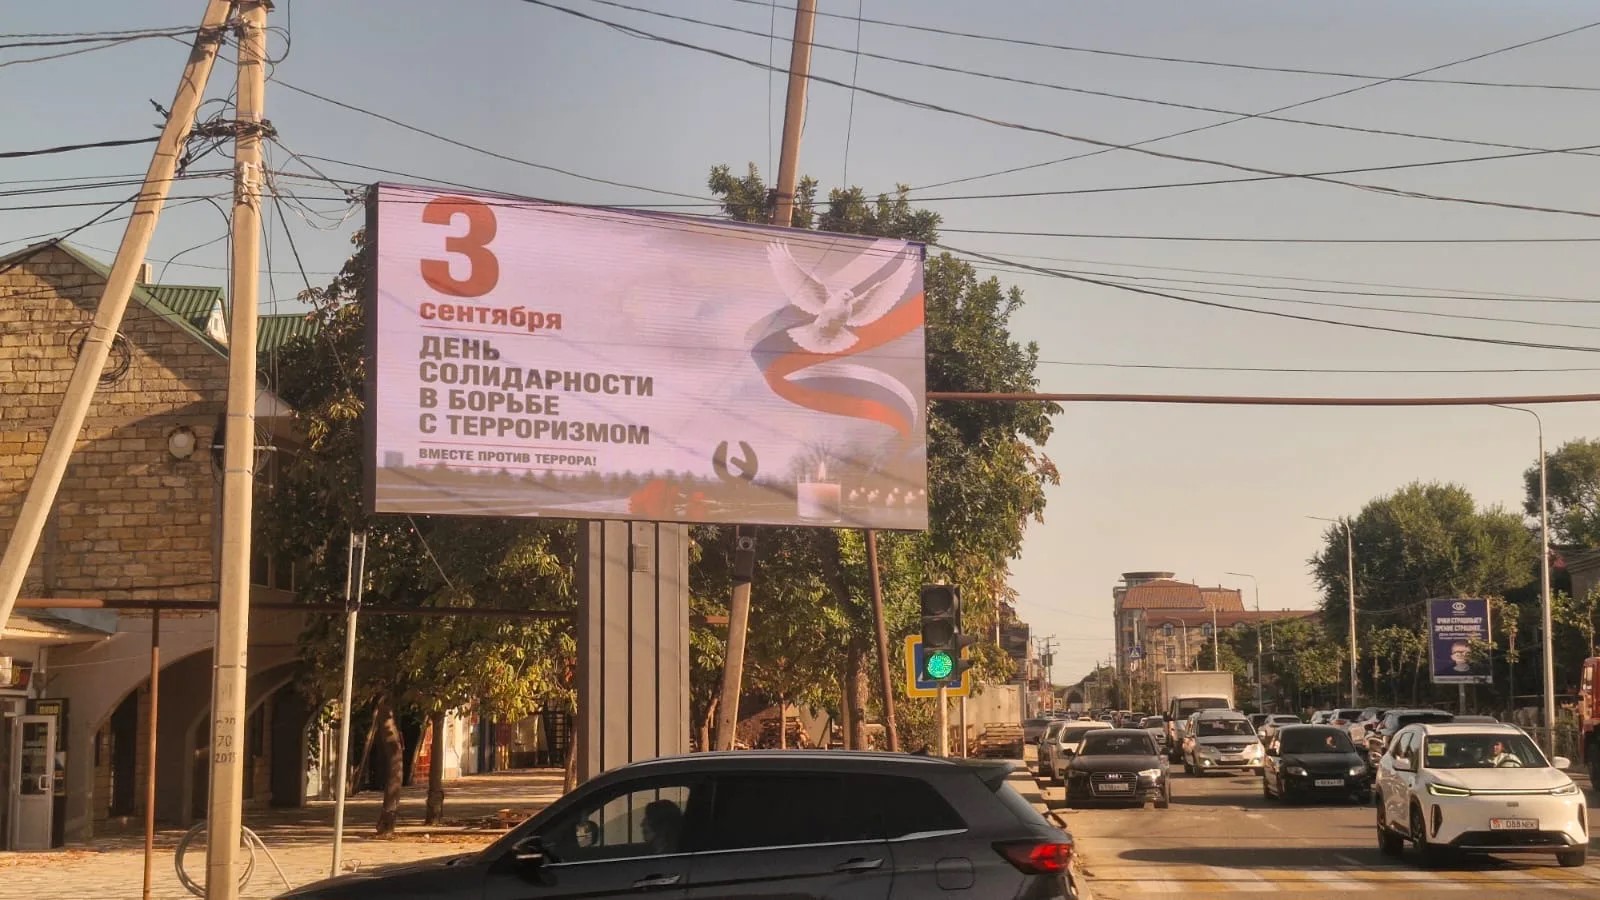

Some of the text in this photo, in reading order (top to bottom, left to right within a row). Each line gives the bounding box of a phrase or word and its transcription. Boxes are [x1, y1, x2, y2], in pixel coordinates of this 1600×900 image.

[420, 195, 500, 298] 3
[419, 301, 563, 332] сентября
[419, 335, 501, 361] ДЕНЬ
[419, 361, 654, 397] СОЛИДАРНОСТИ
[419, 387, 560, 416] В БОРЬБЕ
[419, 413, 651, 445] С ТЕРРОРИЗМОМ
[419, 448, 597, 467] ВМЕСТЕ ПРОТИВ ТЕРРОРА!
